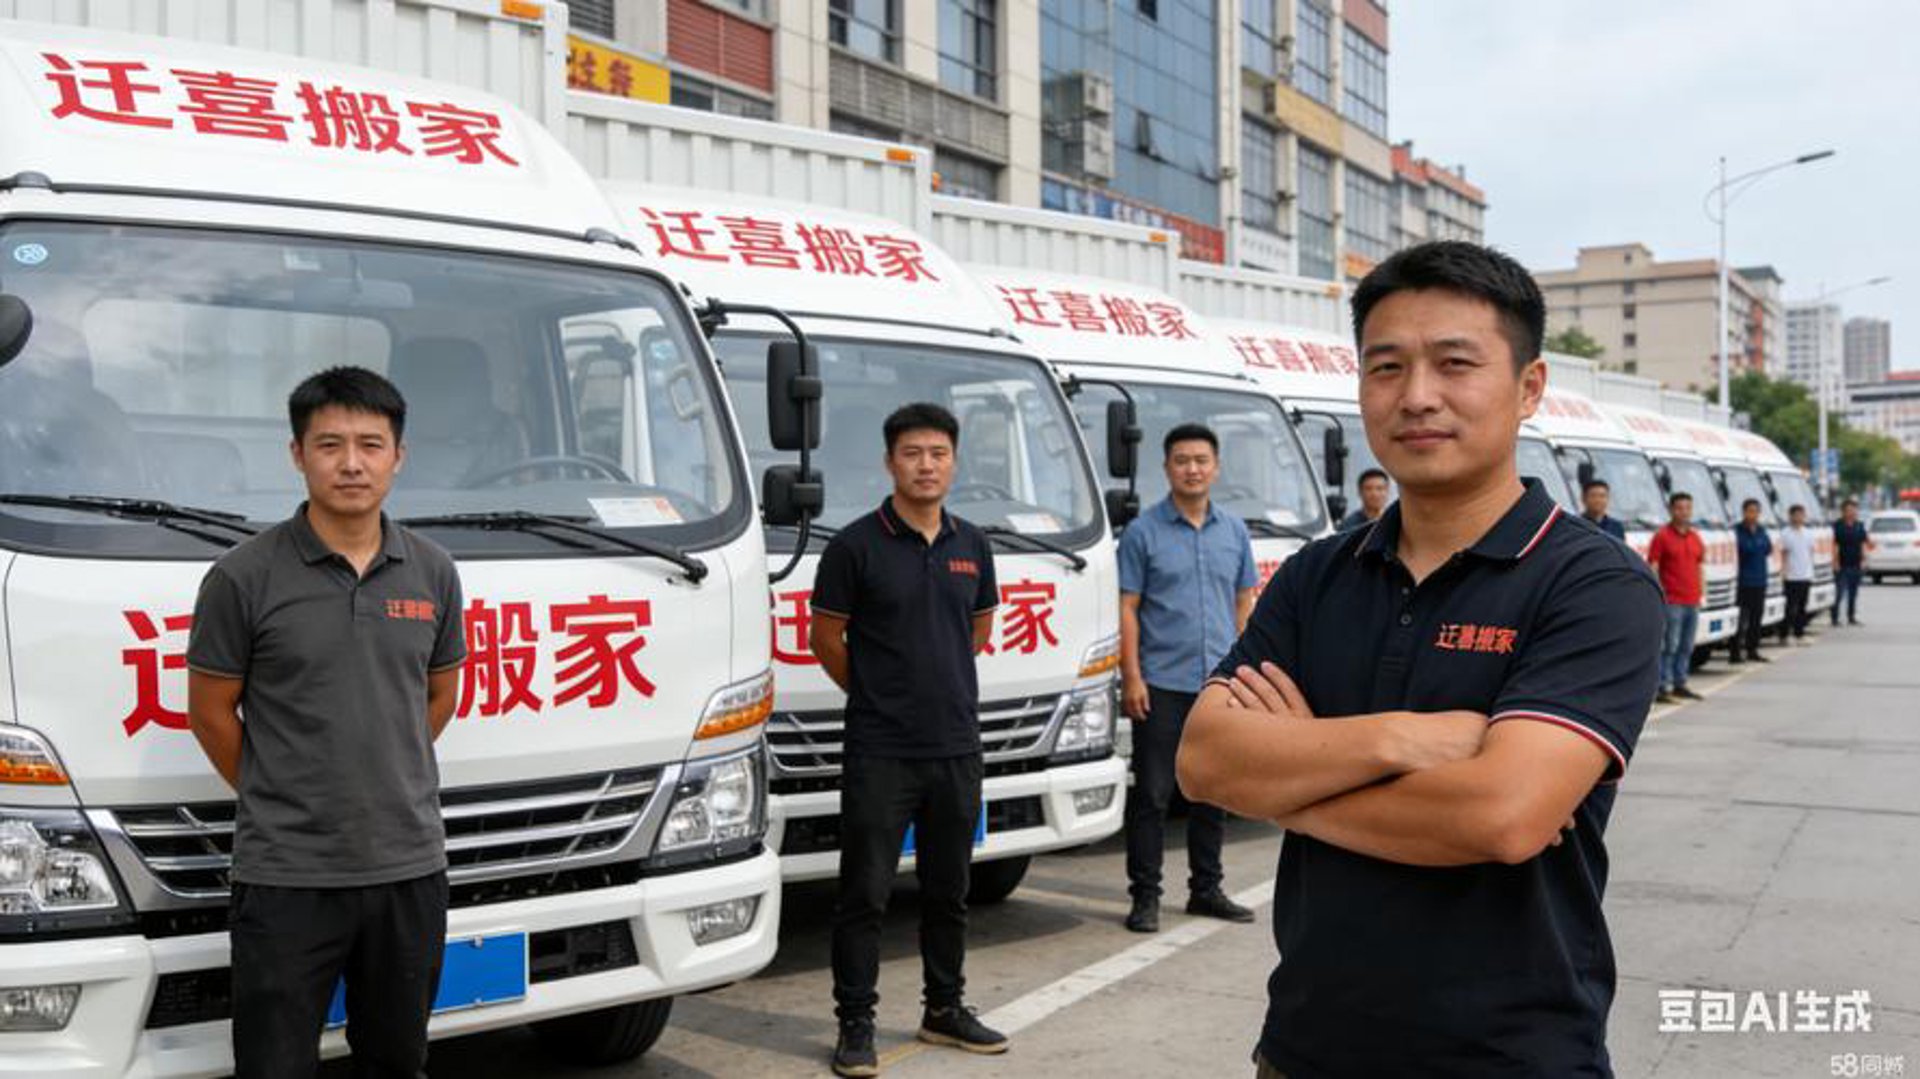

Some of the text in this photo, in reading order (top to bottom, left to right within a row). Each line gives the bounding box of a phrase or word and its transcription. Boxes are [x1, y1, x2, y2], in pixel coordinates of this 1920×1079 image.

[42, 53, 519, 168] 迁喜搬家
[639, 207, 940, 284] 迁喜搬家
[996, 285, 1198, 342] 迁喜搬家
[1435, 623, 1518, 654] 迁喜搬家
